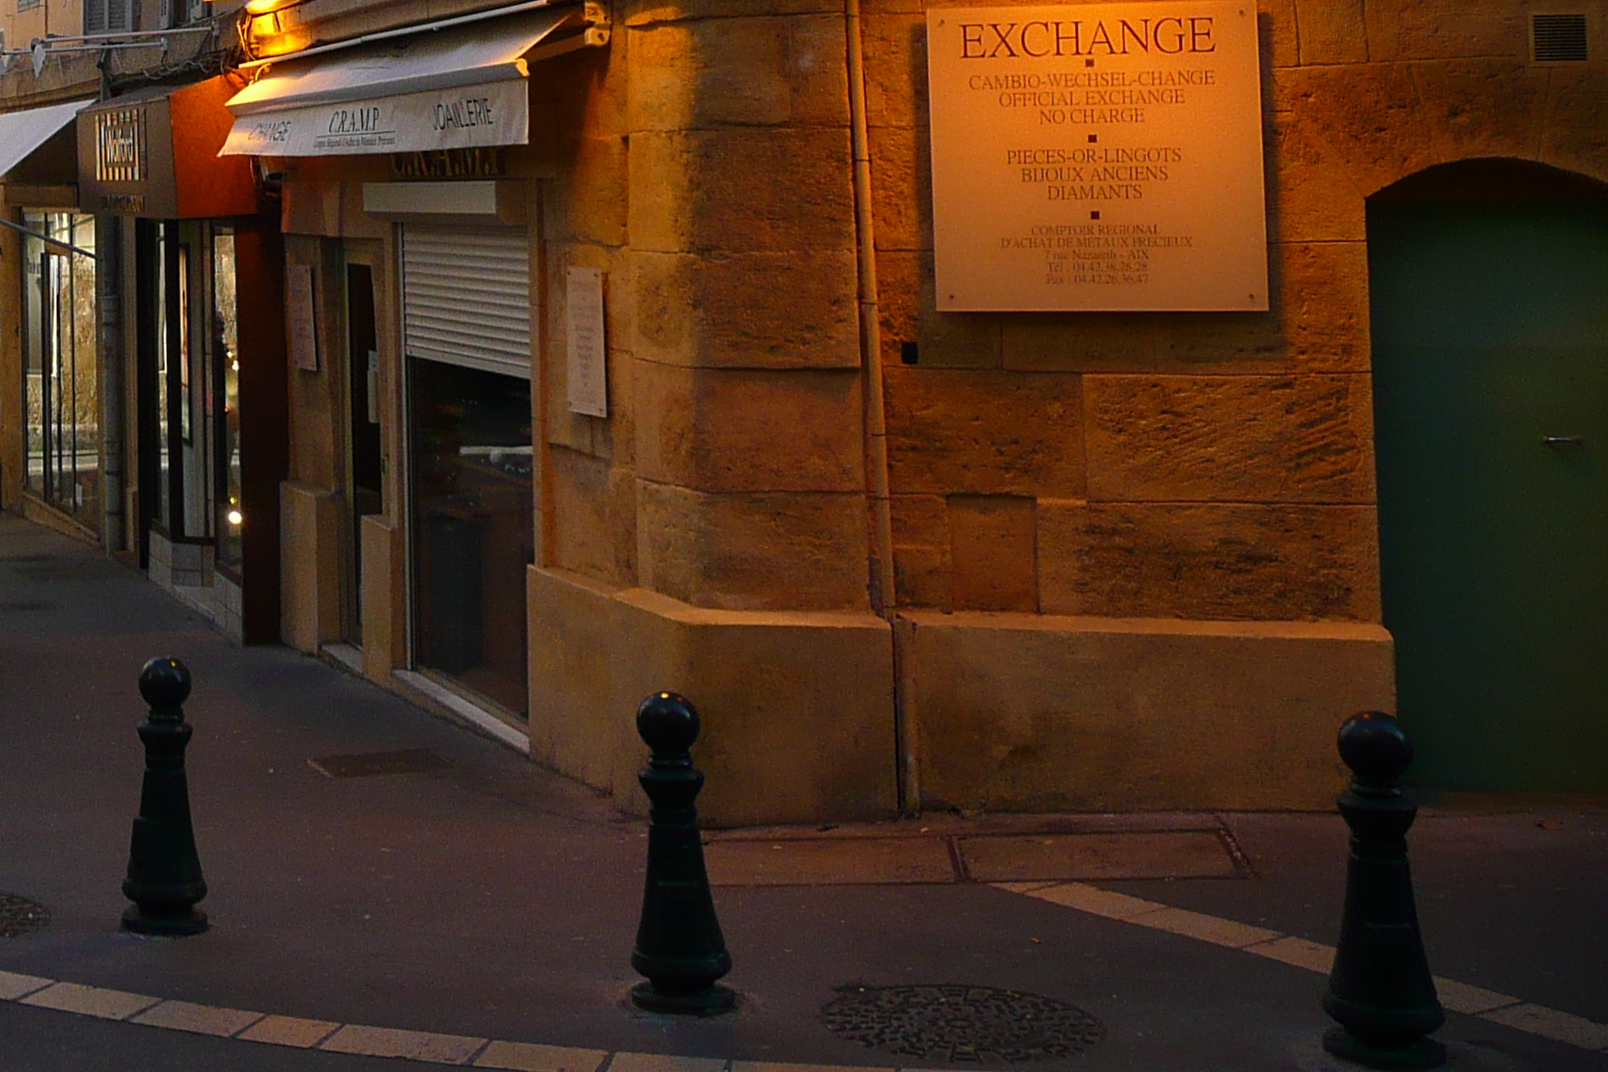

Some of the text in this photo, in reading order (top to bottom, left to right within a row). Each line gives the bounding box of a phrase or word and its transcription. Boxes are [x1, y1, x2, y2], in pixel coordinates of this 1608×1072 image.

[959, 16, 1217, 60] EXCHANGE
[968, 69, 1216, 91] CAMBIO-WECHSEL-CHANGE
[998, 88, 1186, 108] OFFICIAL EXCHANGE
[432, 97, 494, 132] JOAILLERIE
[1039, 107, 1146, 125] NO CHARGE
[1006, 146, 1182, 166] PIECES-OR-LINGOTS
[1020, 165, 1169, 184] BIJOUX ANCIENS
[1046, 183, 1143, 201] DIAMANTS
[1031, 225, 1094, 237] COMPTOIR
[1001, 238, 1053, 249] D'ACHAT
[1056, 237, 1074, 249] DE
